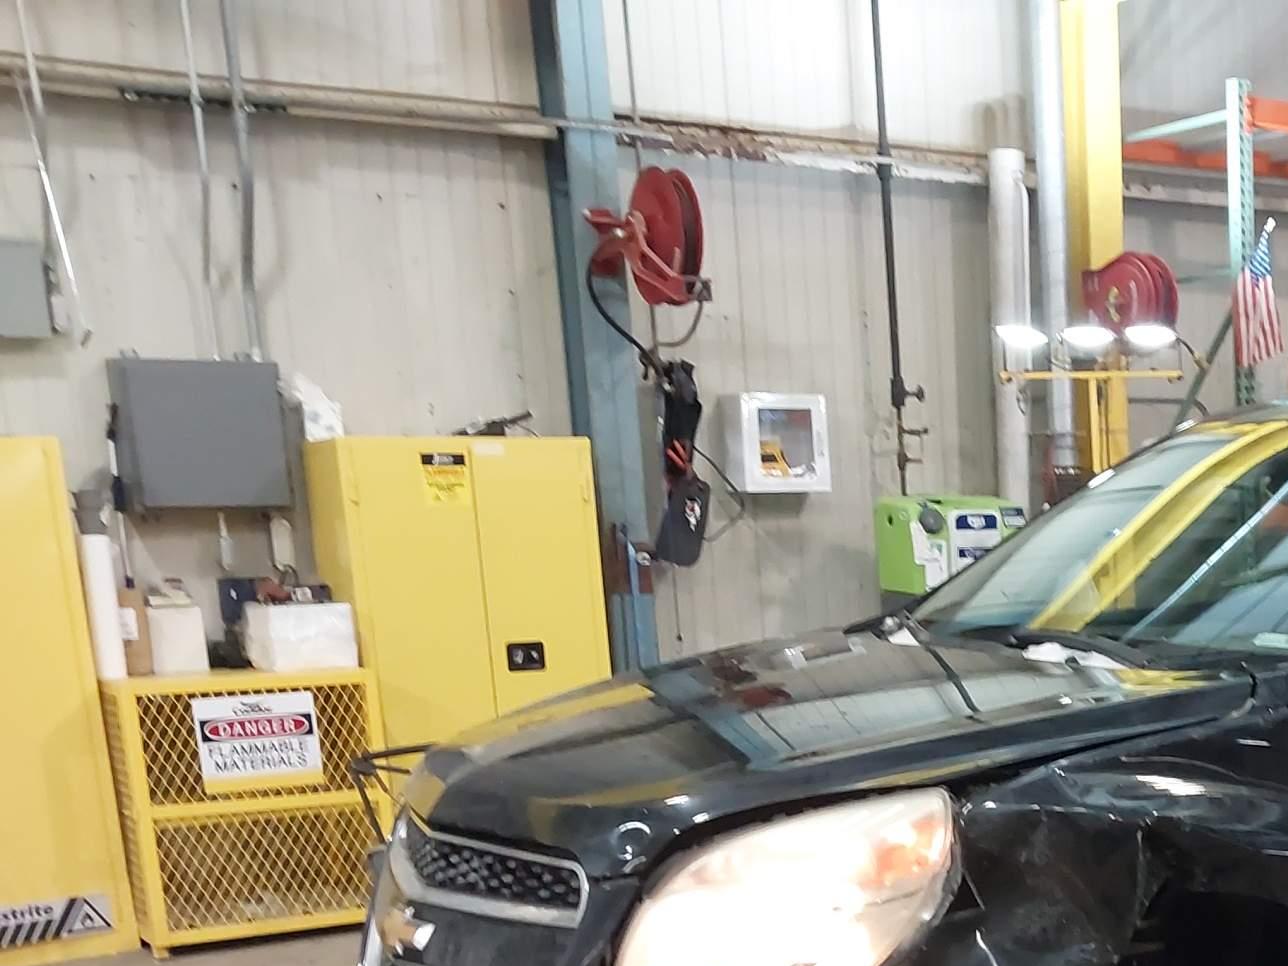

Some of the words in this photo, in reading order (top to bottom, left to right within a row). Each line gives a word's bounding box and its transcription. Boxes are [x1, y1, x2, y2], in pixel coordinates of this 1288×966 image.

[217, 719, 296, 738] DANGER
[208, 739, 305, 758] FLAMMABLE
[214, 753, 307, 773] MATERIALS
